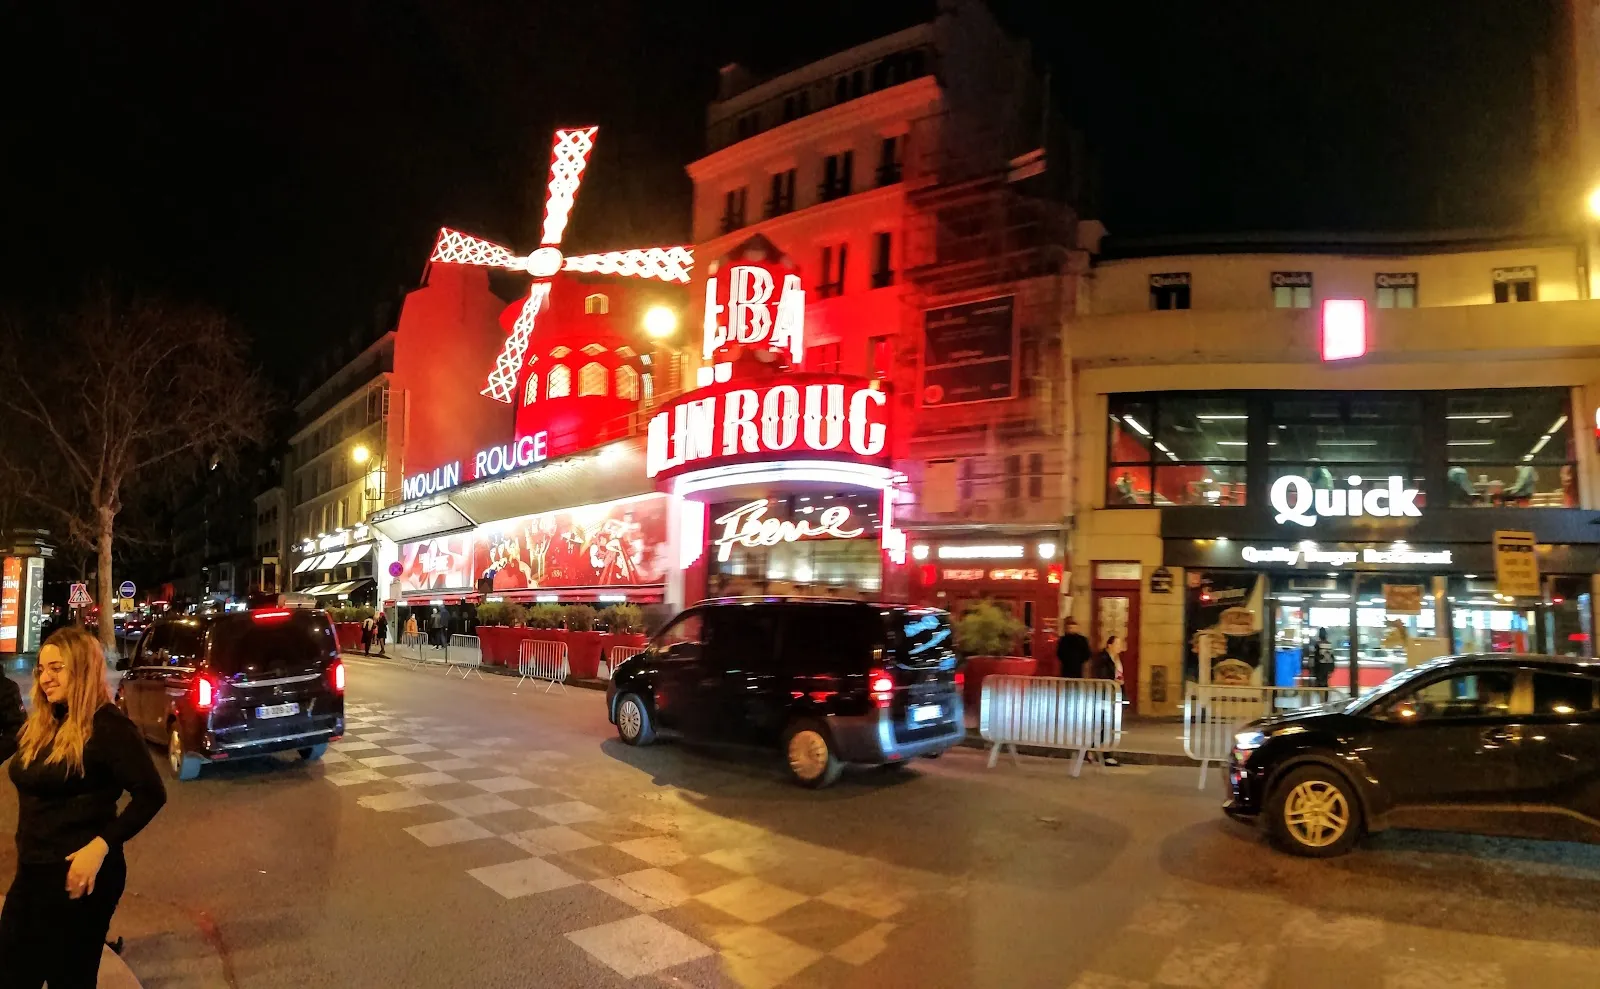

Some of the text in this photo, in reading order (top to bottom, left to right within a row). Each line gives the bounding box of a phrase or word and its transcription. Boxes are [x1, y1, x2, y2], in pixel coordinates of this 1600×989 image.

[403, 431, 548, 500] MOULIN ROUGE
[1270, 475, 1423, 526] Quick
